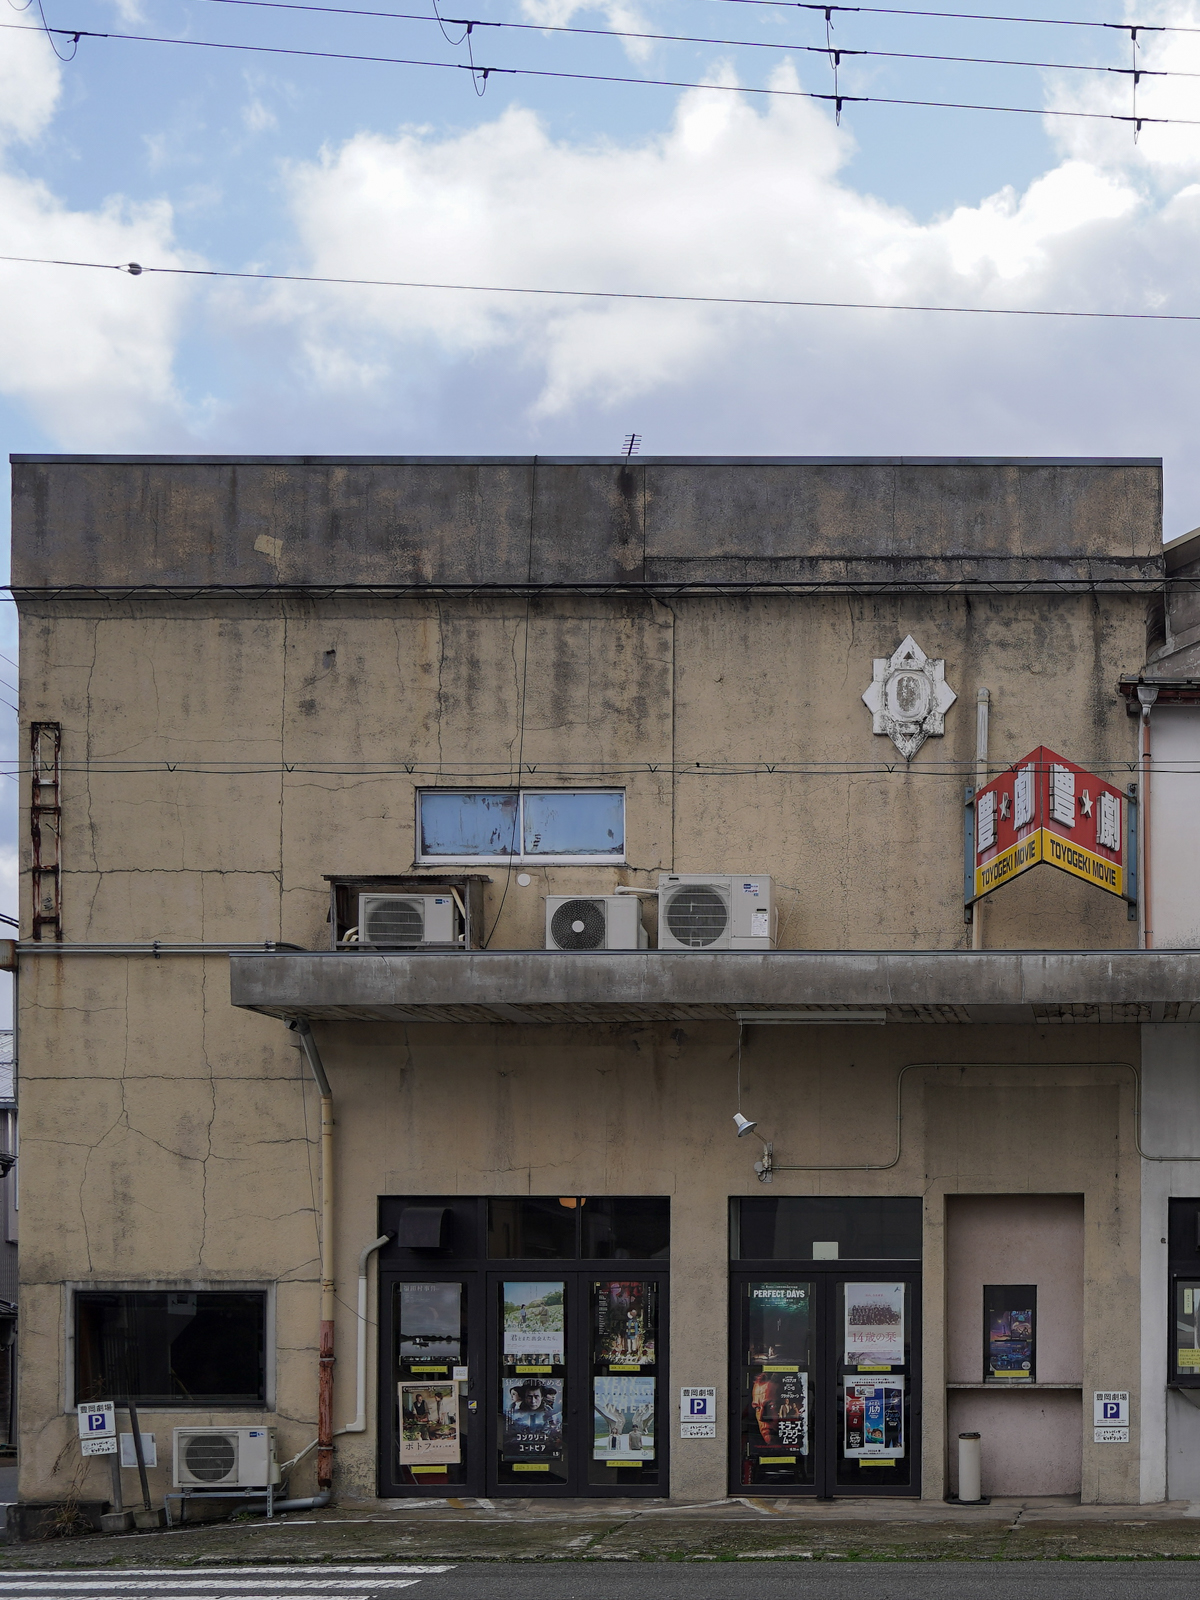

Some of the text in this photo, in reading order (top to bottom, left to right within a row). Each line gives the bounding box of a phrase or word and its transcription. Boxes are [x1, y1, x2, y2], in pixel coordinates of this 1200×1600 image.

[982, 840, 1036, 888] TOYOGEKI MOVIE
[1050, 839, 1116, 887] TOYOGEKI MOVIE
[753, 1290, 806, 1298] PERFECT DAYS
[694, 1400, 704, 1413] P
[1107, 1404, 1117, 1418] P
[92, 1416, 102, 1429] P
[778, 1421, 802, 1430] キラーズ
[405, 1442, 431, 1450] ポトフ
